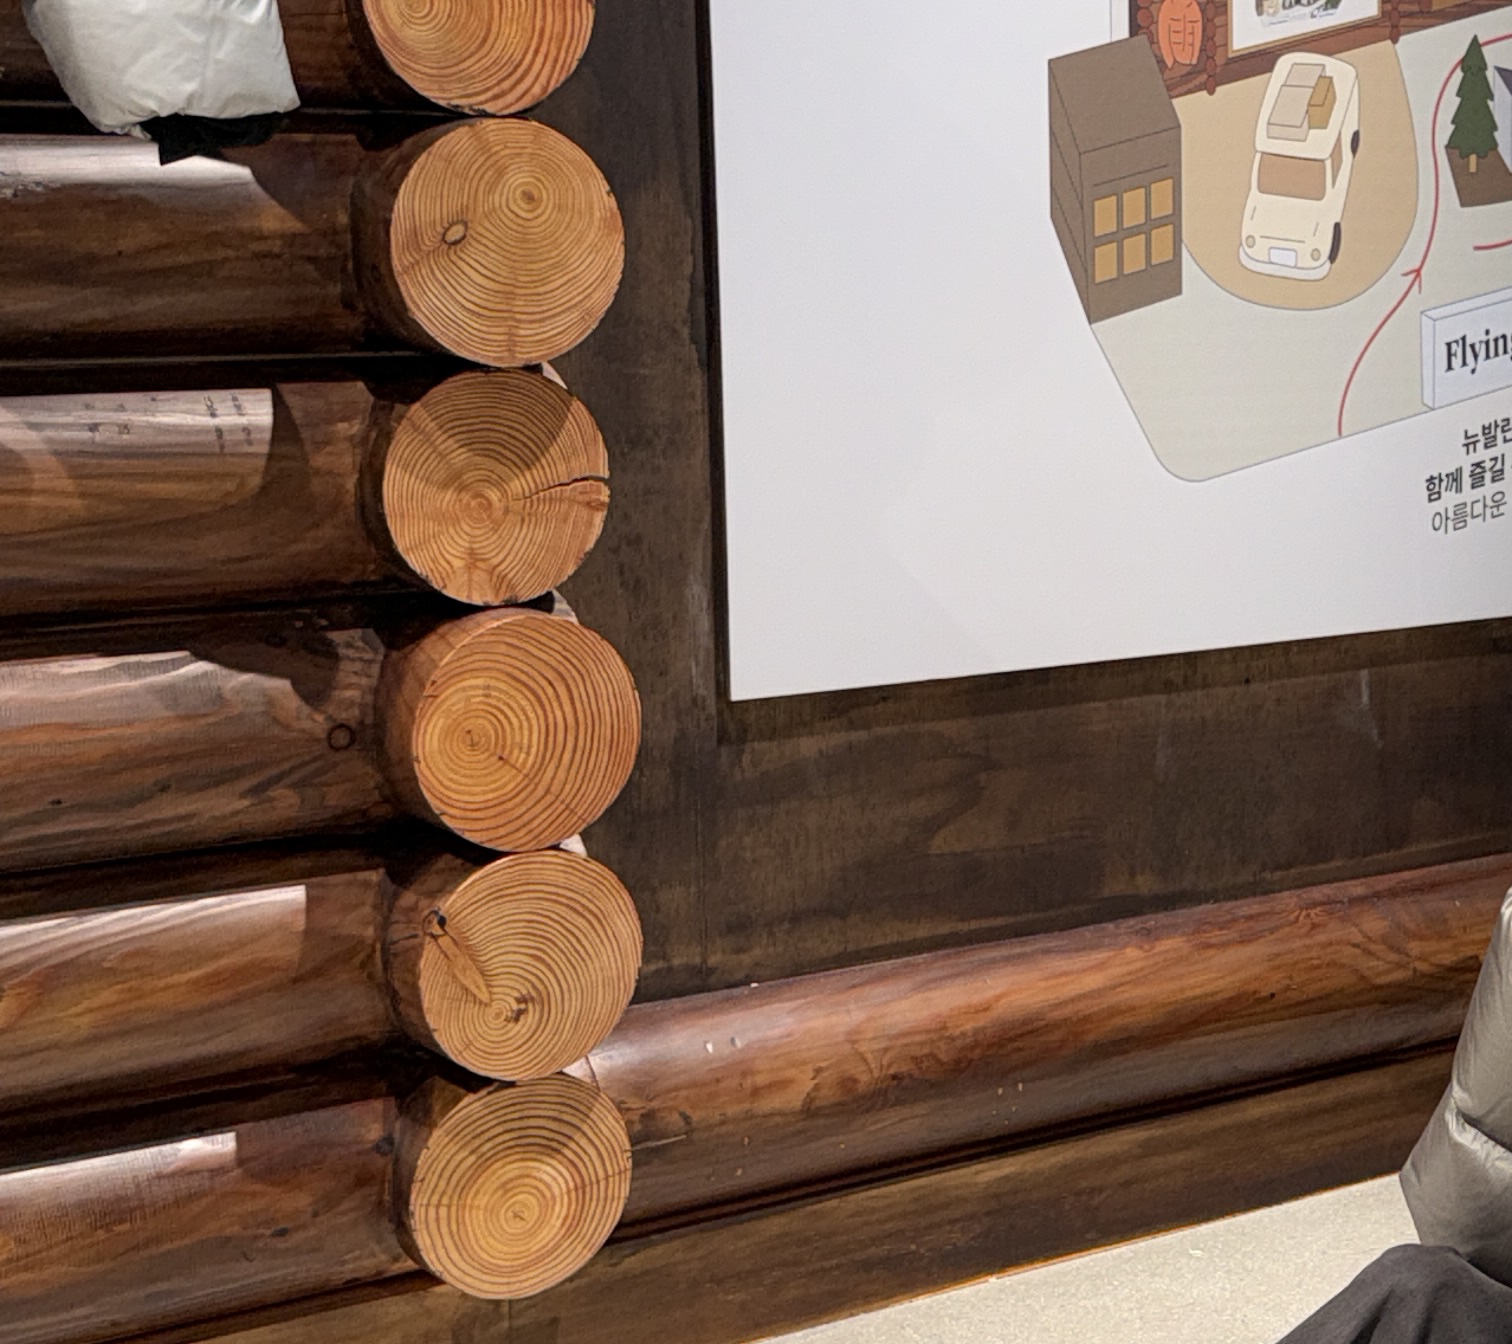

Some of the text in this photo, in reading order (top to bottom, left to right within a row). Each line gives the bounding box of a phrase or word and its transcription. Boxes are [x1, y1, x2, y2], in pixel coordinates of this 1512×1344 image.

[1426, 468, 1462, 504] 함께
[1469, 454, 1505, 490] 즐길
[1431, 490, 1507, 535] 아름다운
